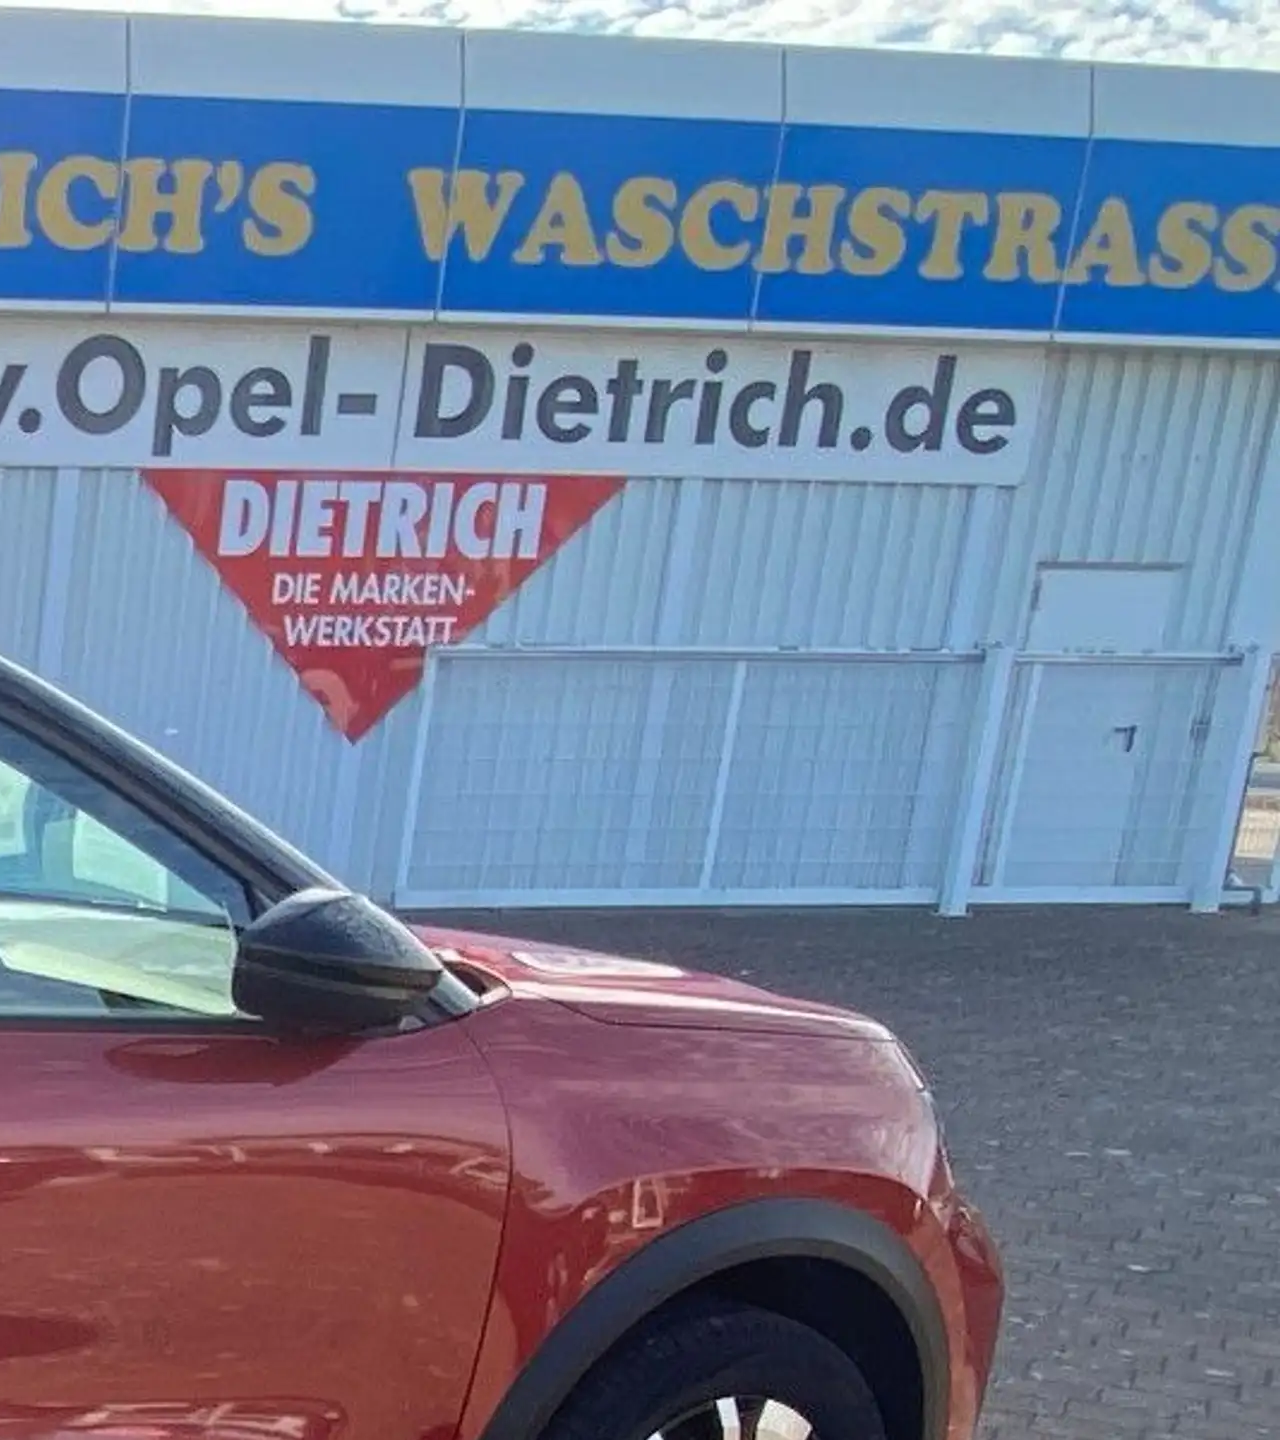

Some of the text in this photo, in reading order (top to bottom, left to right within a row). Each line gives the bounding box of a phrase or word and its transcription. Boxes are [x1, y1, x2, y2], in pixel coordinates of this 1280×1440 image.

[406, 166, 1280, 293] WASCHSTRASS
[217, 479, 547, 560] DIETRICH
[272, 573, 476, 606] DIE MARKEN-
[283, 615, 457, 648] WERKSTATT
